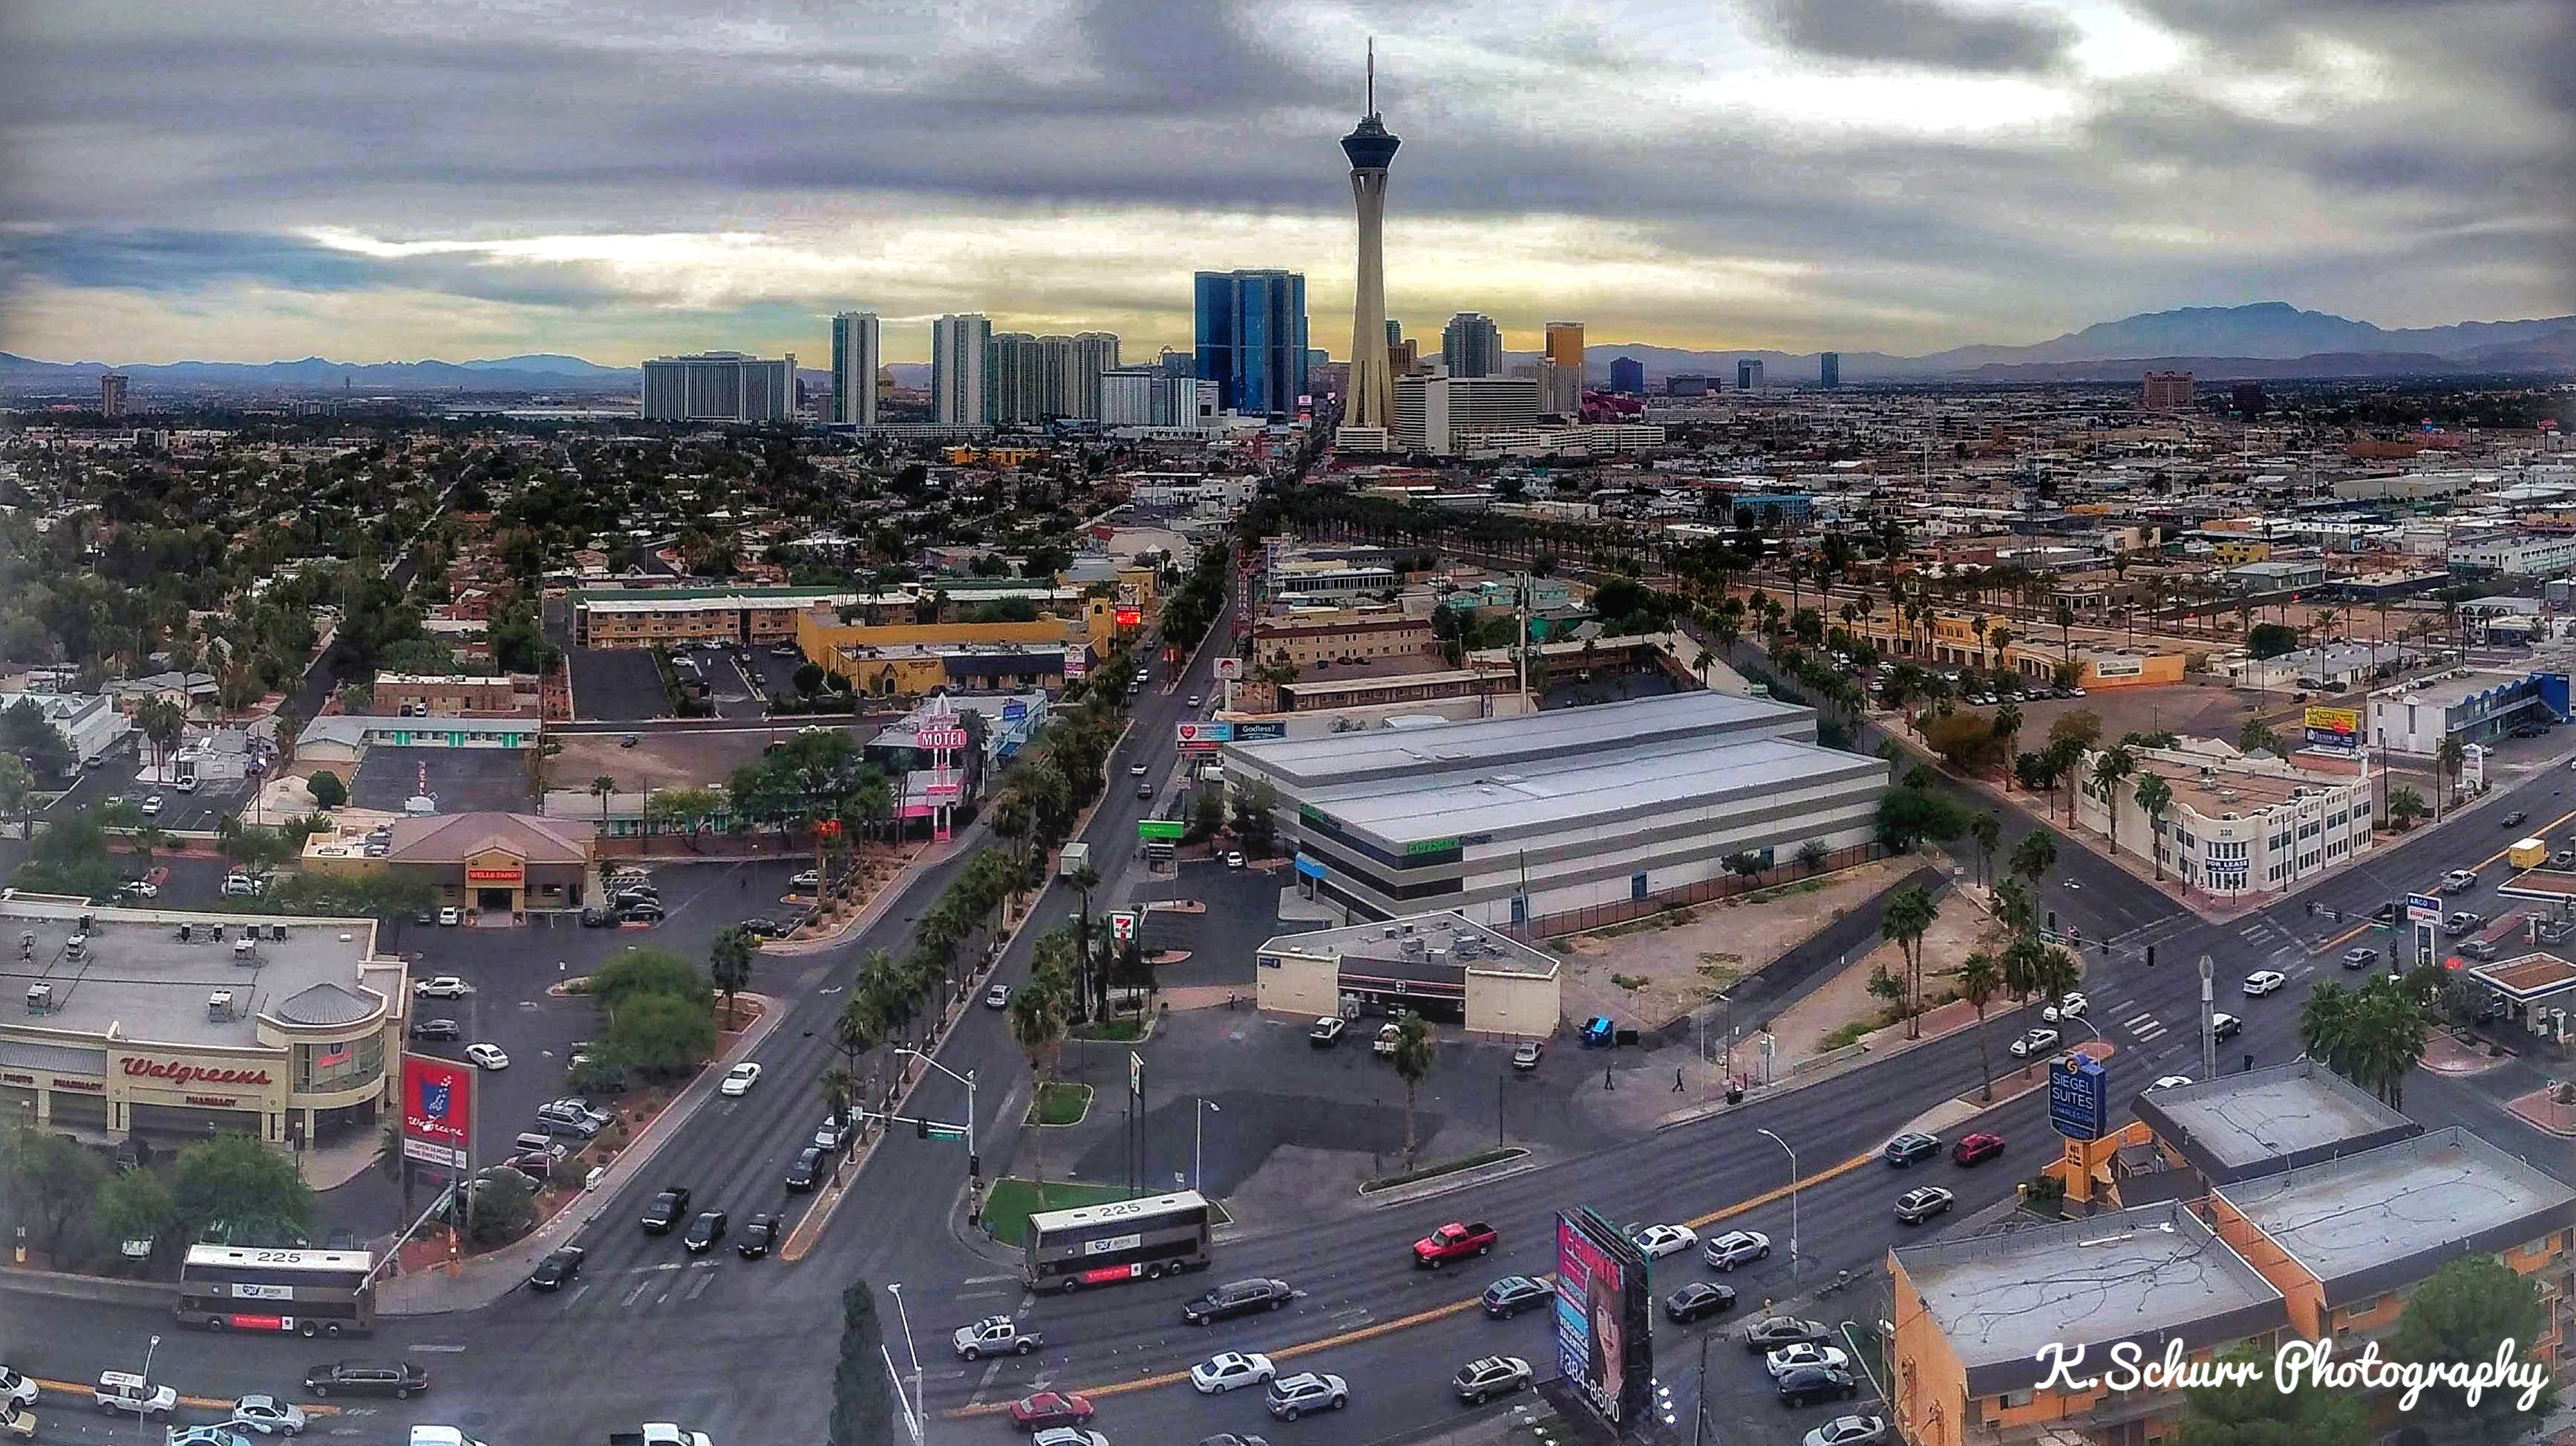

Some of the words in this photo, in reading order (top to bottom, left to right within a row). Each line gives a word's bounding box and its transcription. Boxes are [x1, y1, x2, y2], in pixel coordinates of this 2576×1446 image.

[1242, 724, 1275, 733] Godless?
[922, 733, 964, 746] MOTEL
[2410, 897, 2428, 906] ARCO
[120, 1057, 272, 1084] Walgreens
[2052, 1072, 2093, 1095] SIEGEL
[2052, 1087, 2093, 1110] SUITES
[1099, 1204, 1140, 1217] 225
[257, 1252, 301, 1263] 225
[1559, 1313, 1589, 1351] VERONICA
[1563, 1352, 1620, 1423] 384-8600
